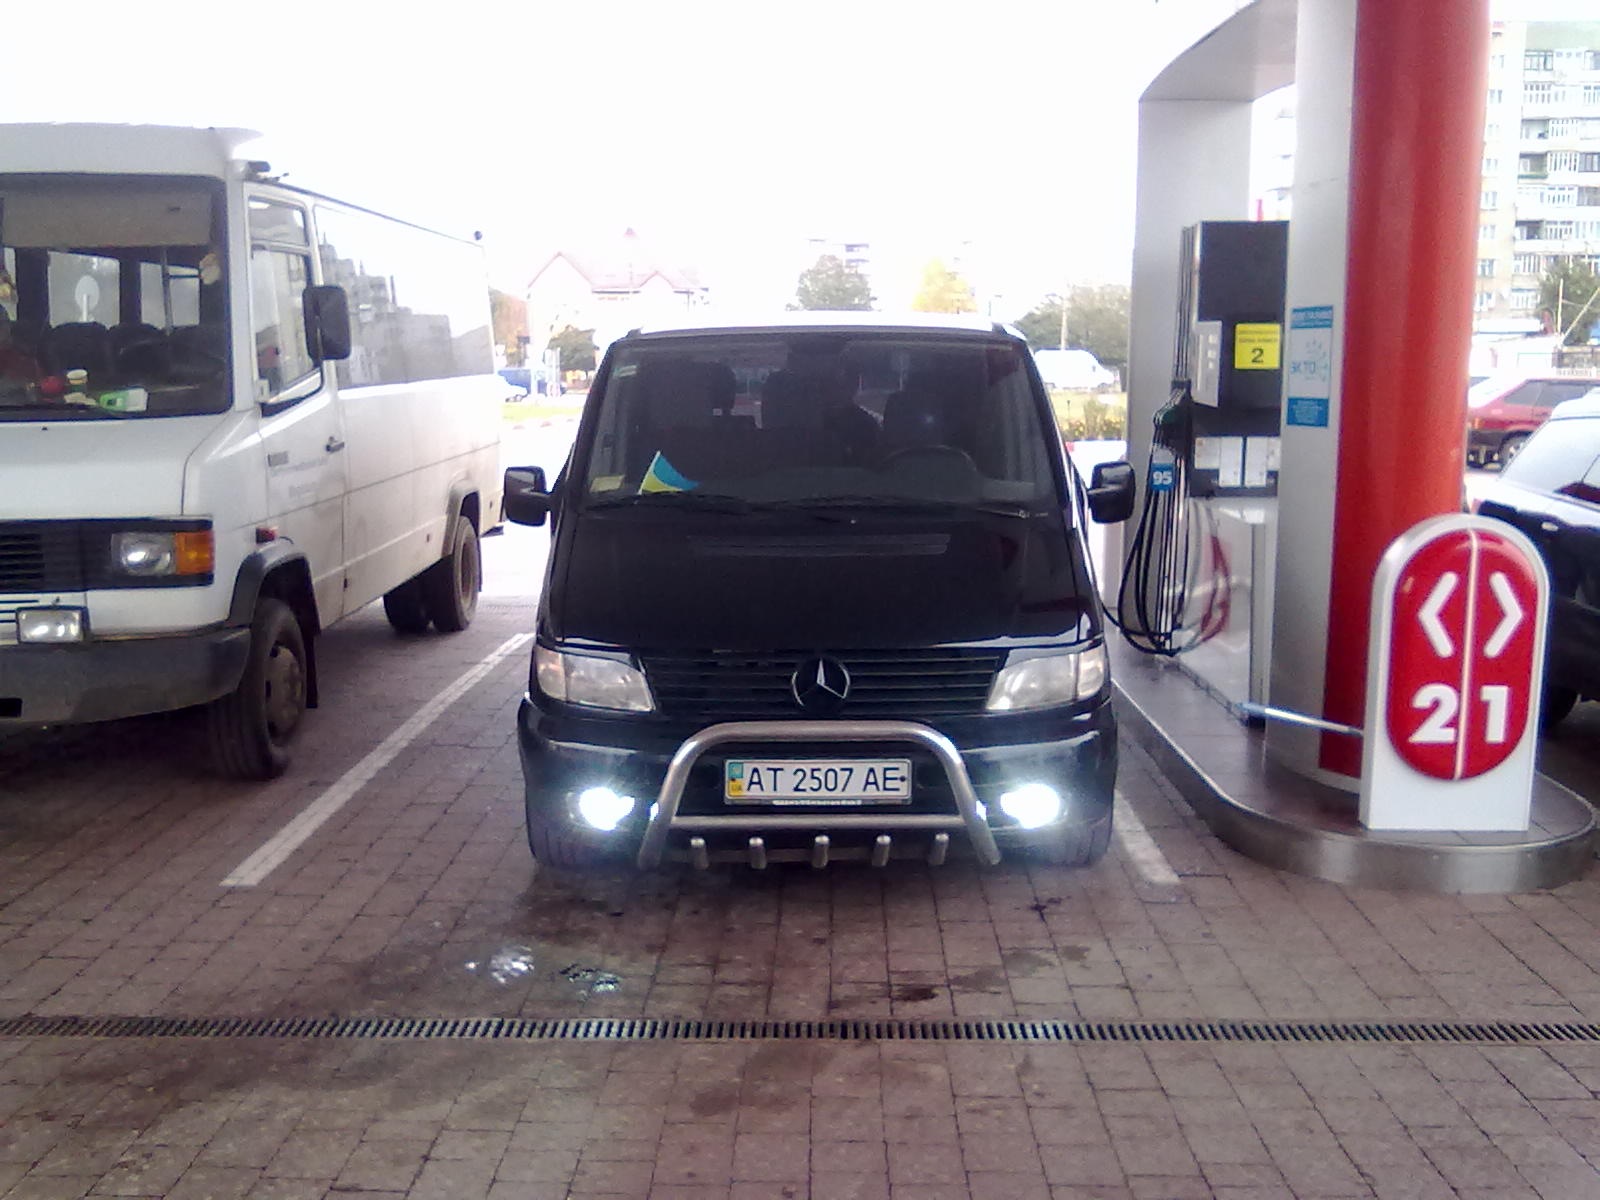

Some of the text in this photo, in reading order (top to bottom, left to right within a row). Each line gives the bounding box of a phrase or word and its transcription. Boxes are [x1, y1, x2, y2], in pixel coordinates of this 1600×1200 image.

[1251, 348, 1264, 363] 2
[1152, 470, 1173, 485] 95
[1408, 683, 1510, 743] 2 1
[747, 767, 900, 792] AT 2507 AE
